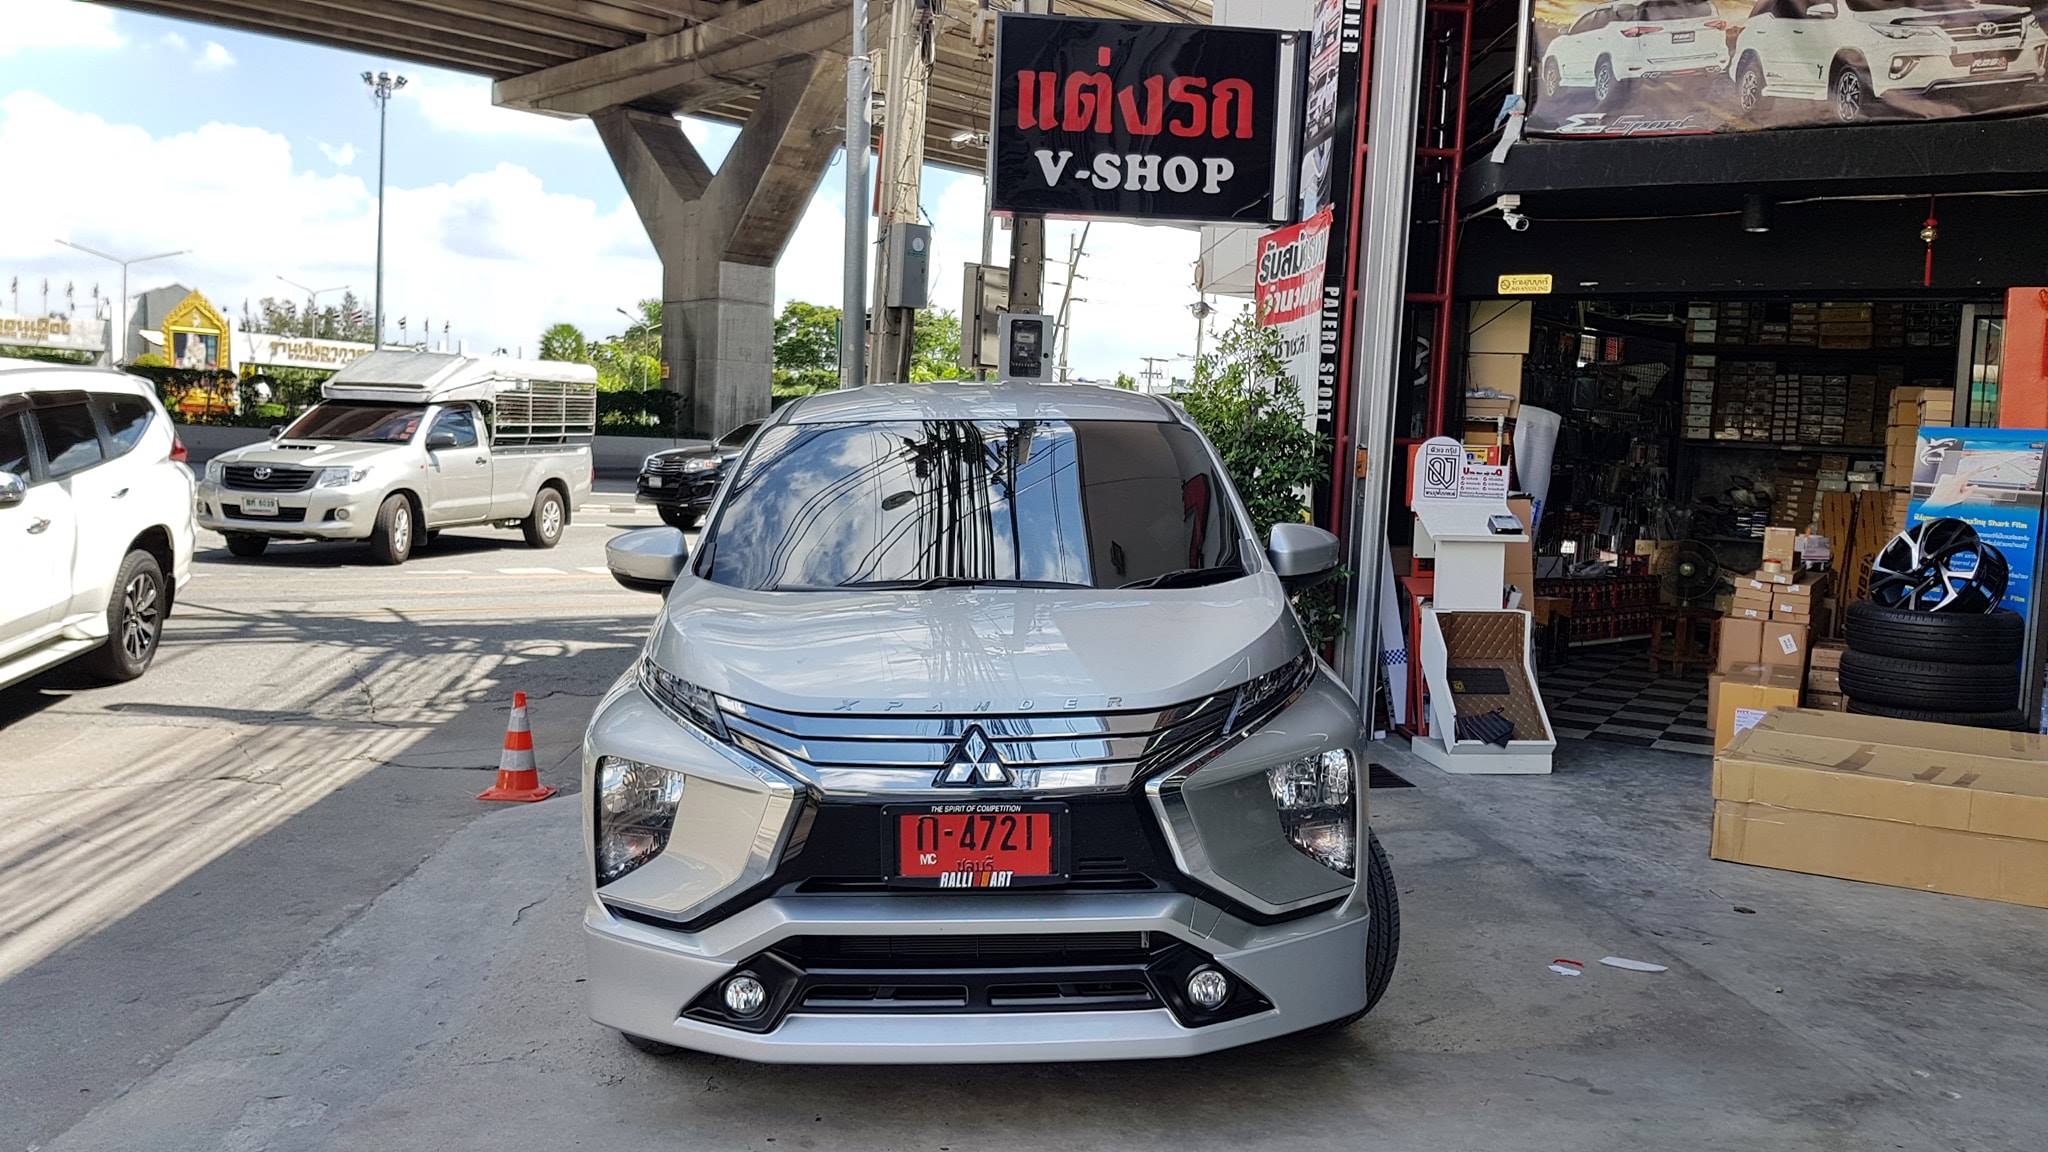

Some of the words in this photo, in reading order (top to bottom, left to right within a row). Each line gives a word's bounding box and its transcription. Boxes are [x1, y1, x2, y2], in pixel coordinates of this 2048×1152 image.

[1034, 150, 1235, 194] V-SHOP
[1319, 286, 1340, 354] PAJERO
[1317, 362, 1335, 423] SPORT
[1987, 519, 2010, 528] Shark
[2011, 520, 2028, 529] Film
[833, 696, 1124, 713] XPANDER
[931, 805, 943, 813] THE
[944, 805, 966, 813] SPIRIT
[966, 805, 976, 813] OF
[976, 804, 1021, 813] COMPETITION
[920, 853, 937, 865] MC
[956, 855, 994, 873] ชลบรี
